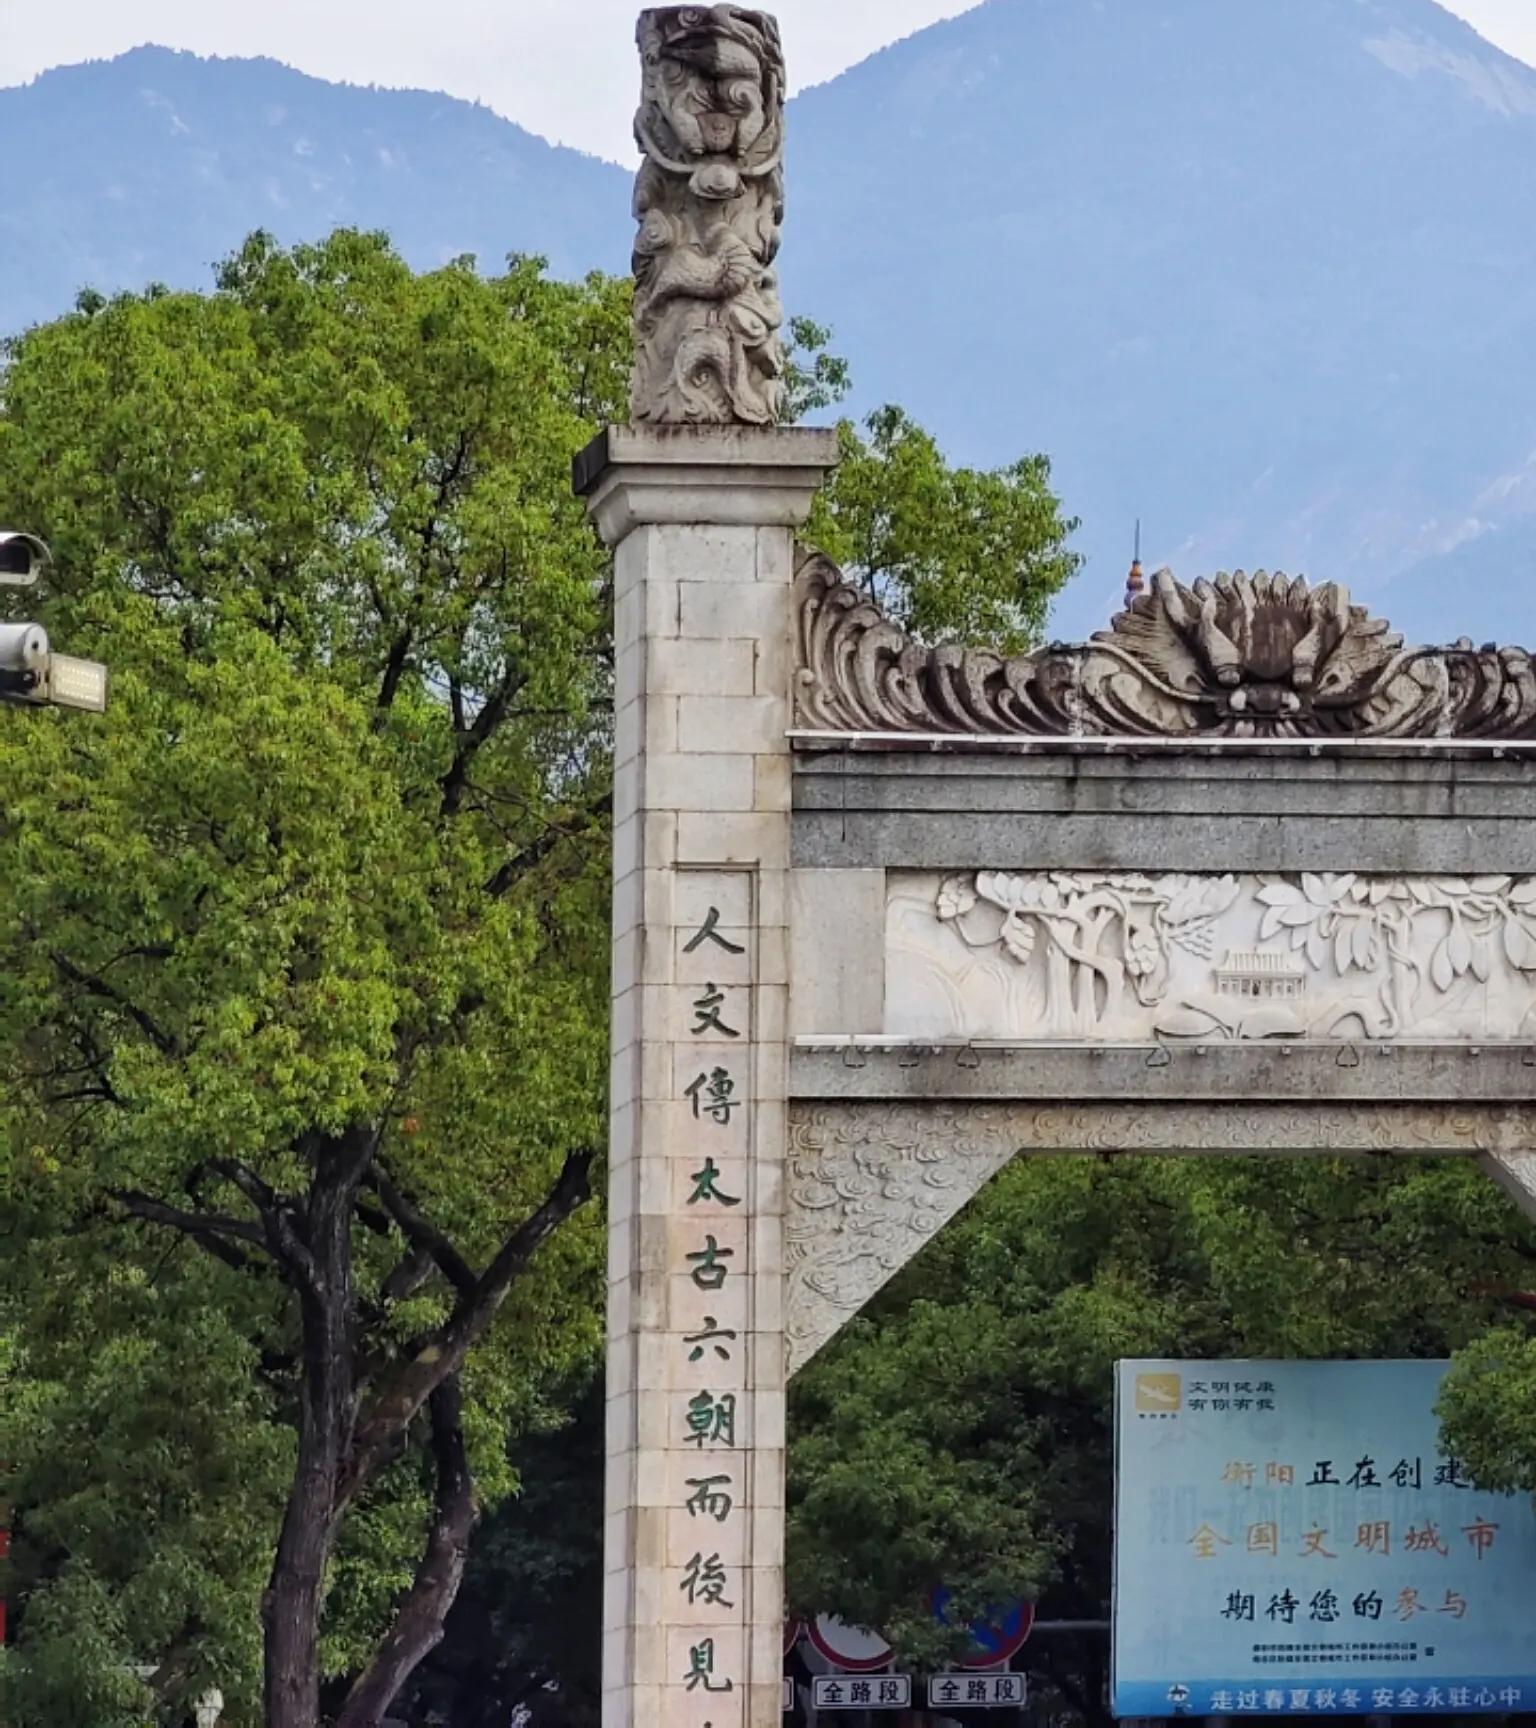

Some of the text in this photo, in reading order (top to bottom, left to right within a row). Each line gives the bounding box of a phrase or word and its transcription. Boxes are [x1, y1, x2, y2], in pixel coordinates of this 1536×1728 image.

[679, 906, 746, 1728] 人文傳太古六朝而後見
[1188, 1381, 1276, 1394] 文明健康
[1186, 1515, 1500, 1560] 全国文明城市
[1220, 1587, 1468, 1623] 期待您的参与
[823, 1681, 899, 1704] 全路段
[940, 1678, 1015, 1701] 全路段
